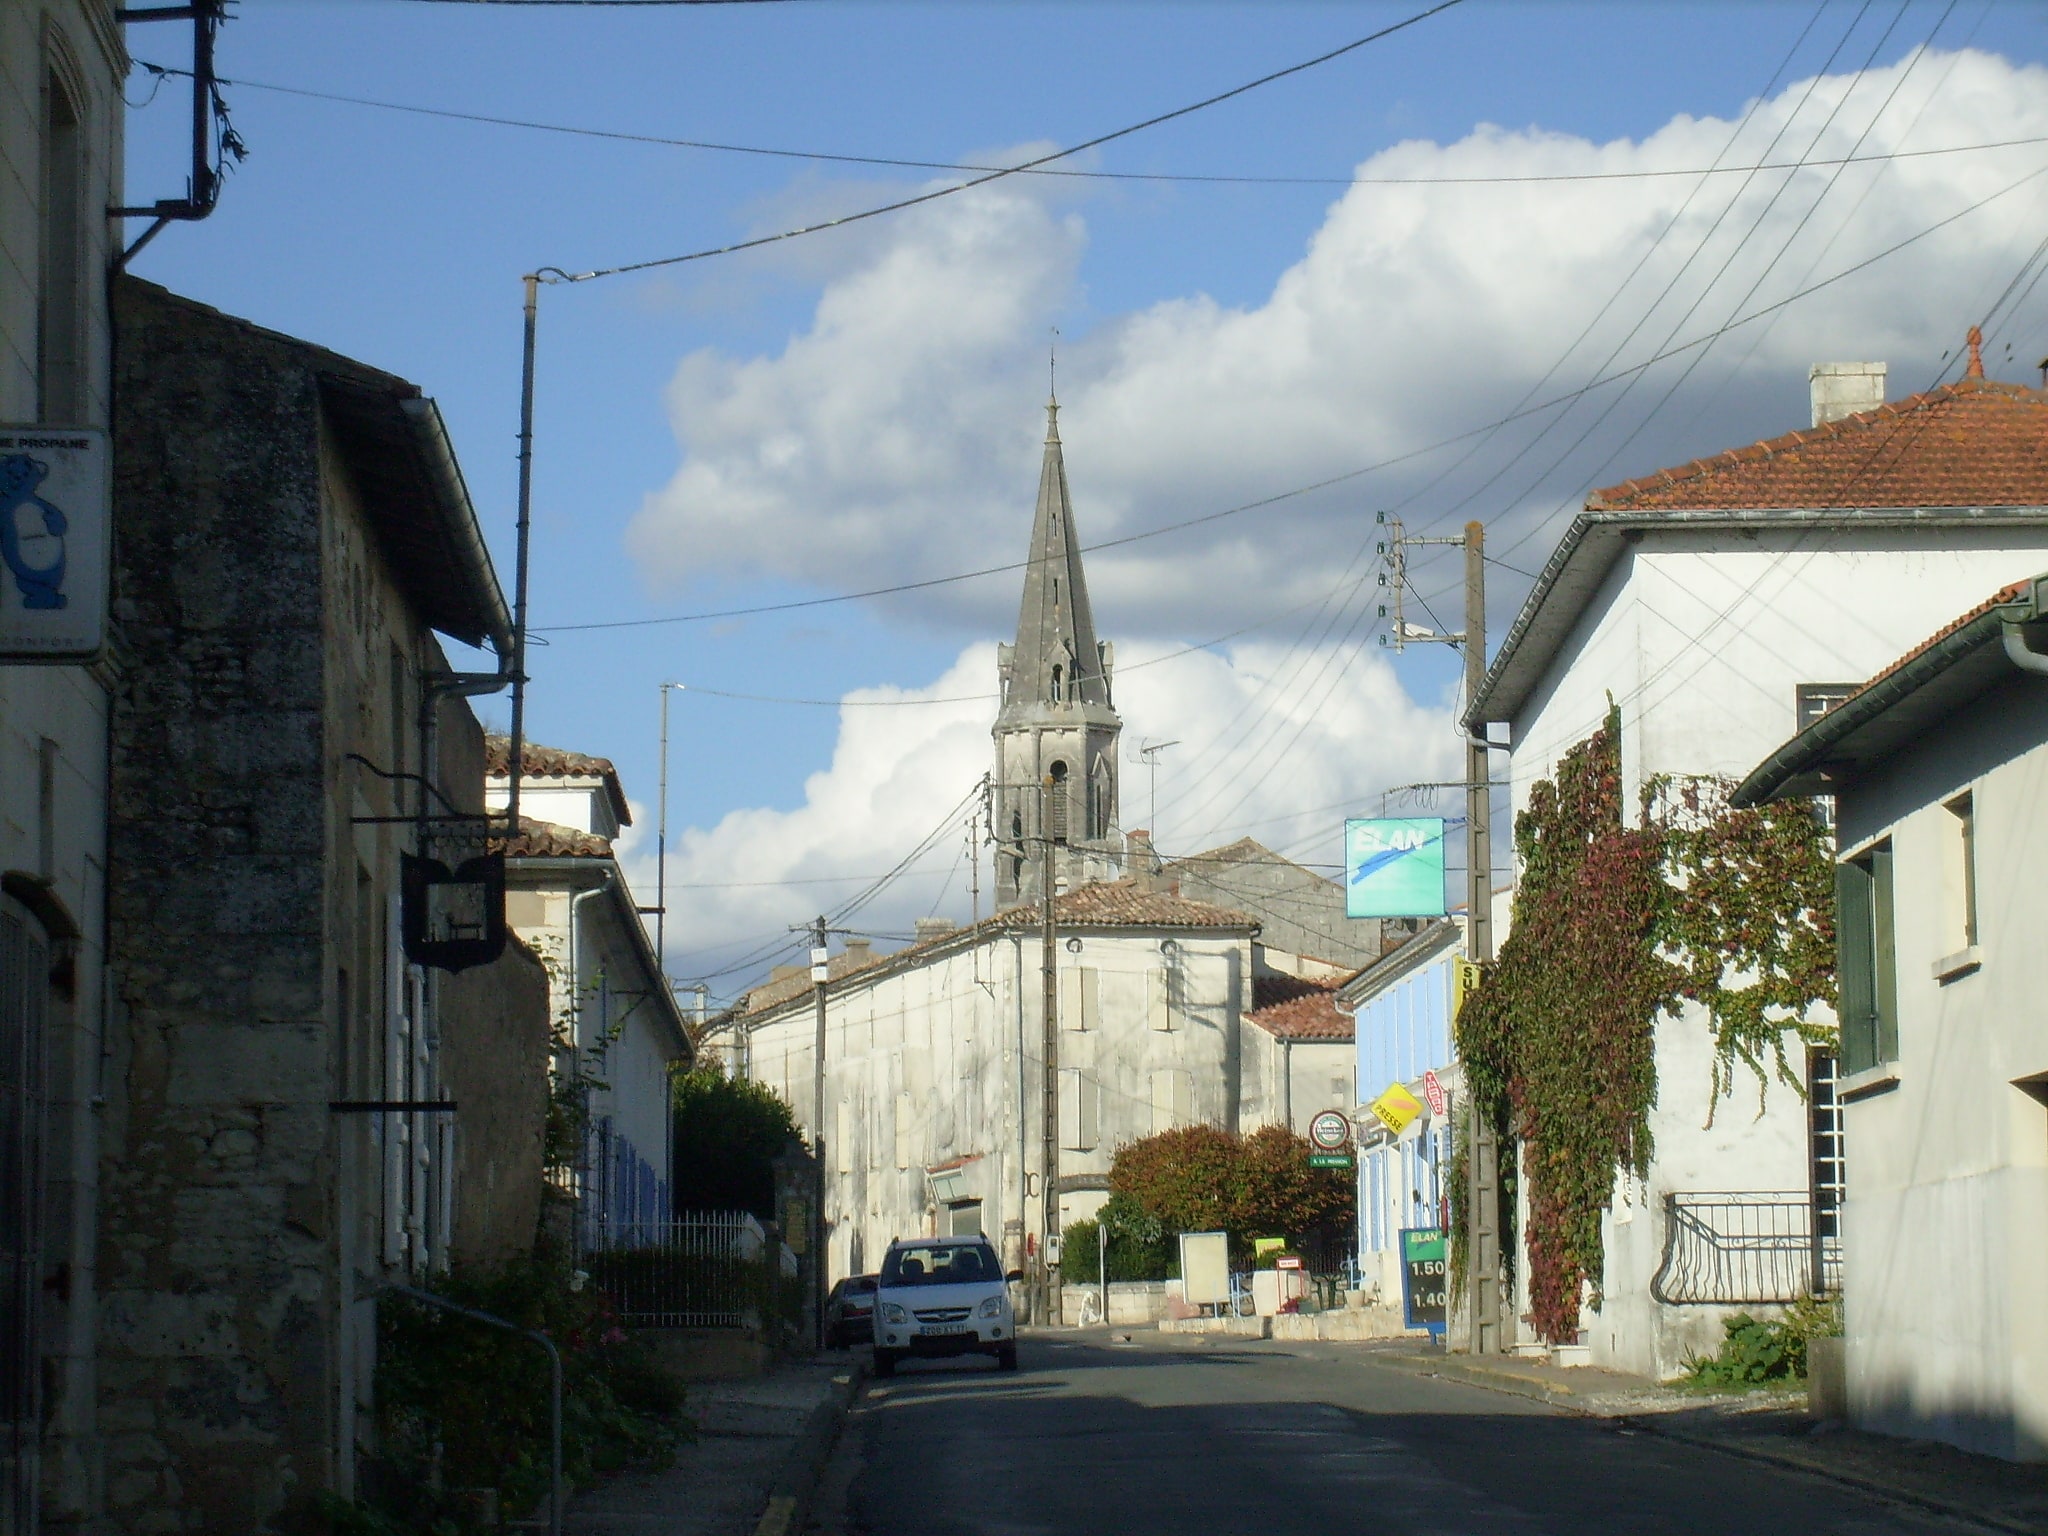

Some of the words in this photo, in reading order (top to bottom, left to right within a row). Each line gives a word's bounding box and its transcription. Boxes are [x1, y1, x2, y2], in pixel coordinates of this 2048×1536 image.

[18, 438, 89, 450] PROPANE
[1427, 1074, 1442, 1113] TABAC
[1376, 1104, 1403, 1131] PRESSE
[1317, 1125, 1343, 1134] Heineken
[1411, 1261, 1445, 1276] 1.50
[1414, 1292, 1447, 1308] 1.40
